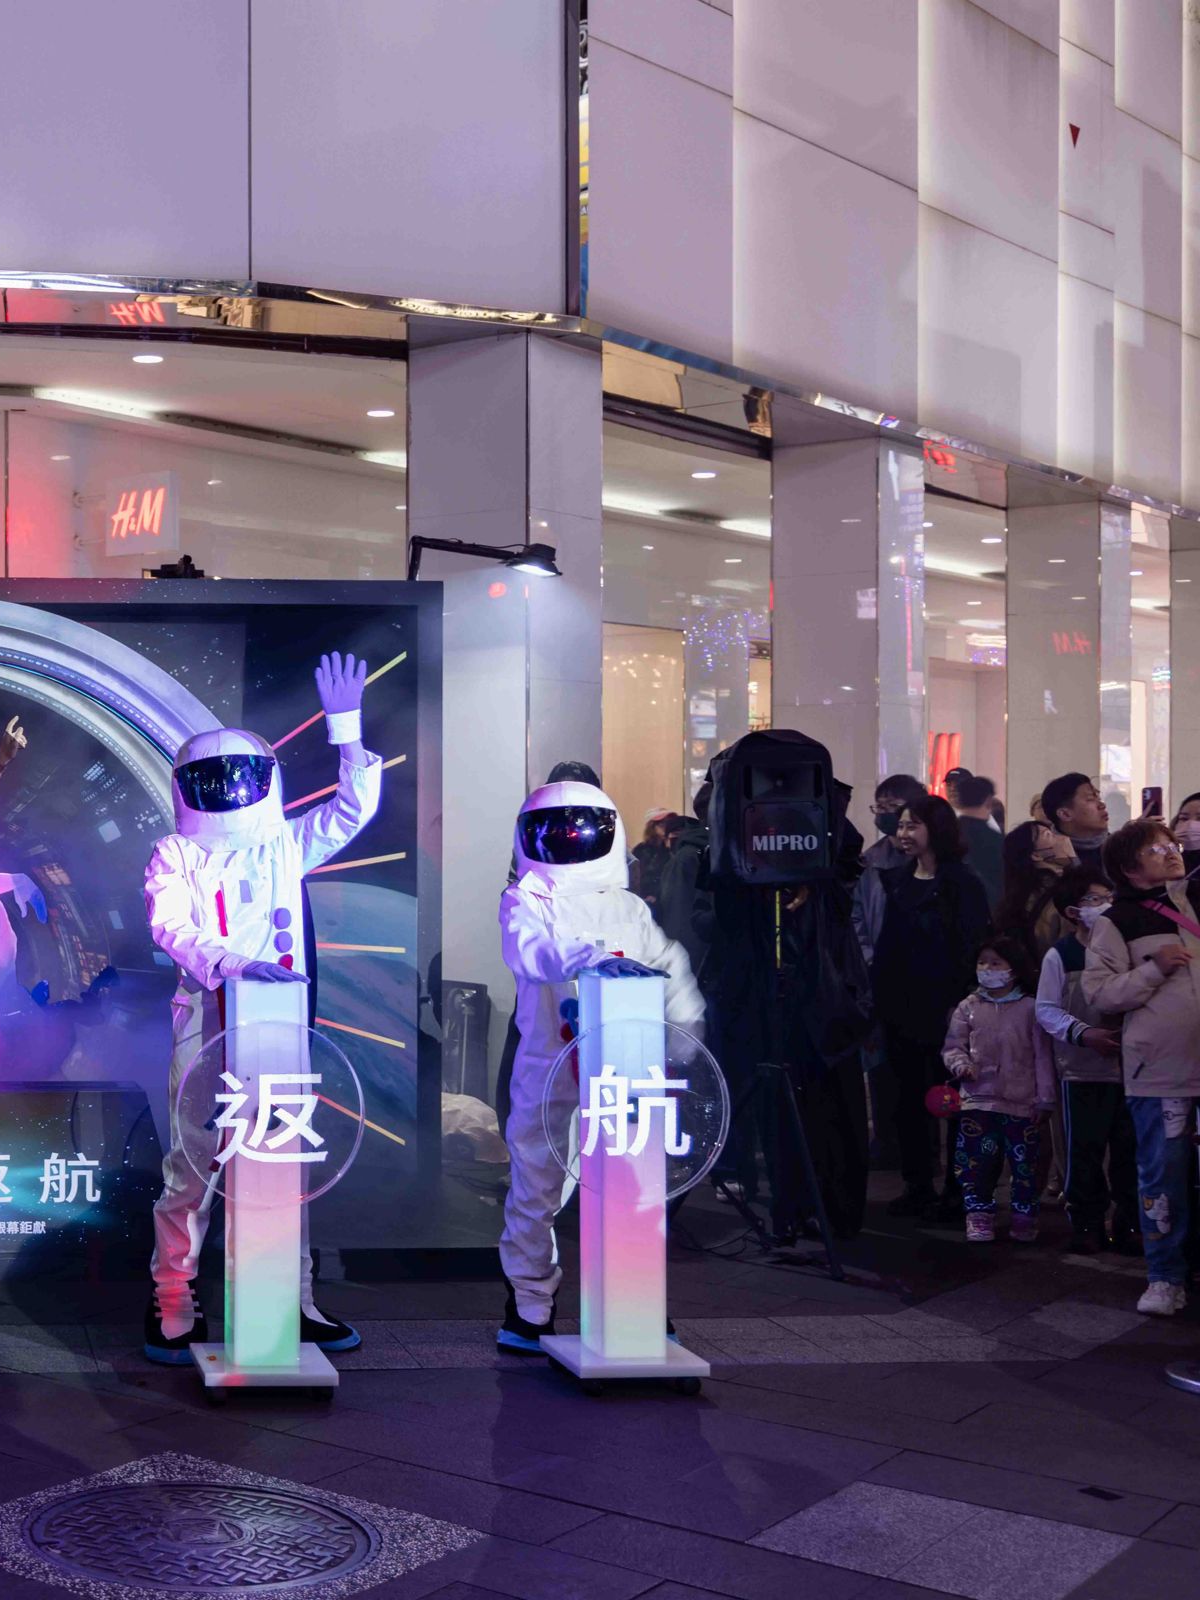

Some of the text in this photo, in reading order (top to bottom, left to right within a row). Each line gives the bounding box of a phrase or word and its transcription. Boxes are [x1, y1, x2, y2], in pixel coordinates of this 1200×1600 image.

[111, 487, 166, 539] H&M
[752, 827, 818, 851] MIPRO
[213, 1071, 328, 1164] 返
[581, 1064, 692, 1157] 航
